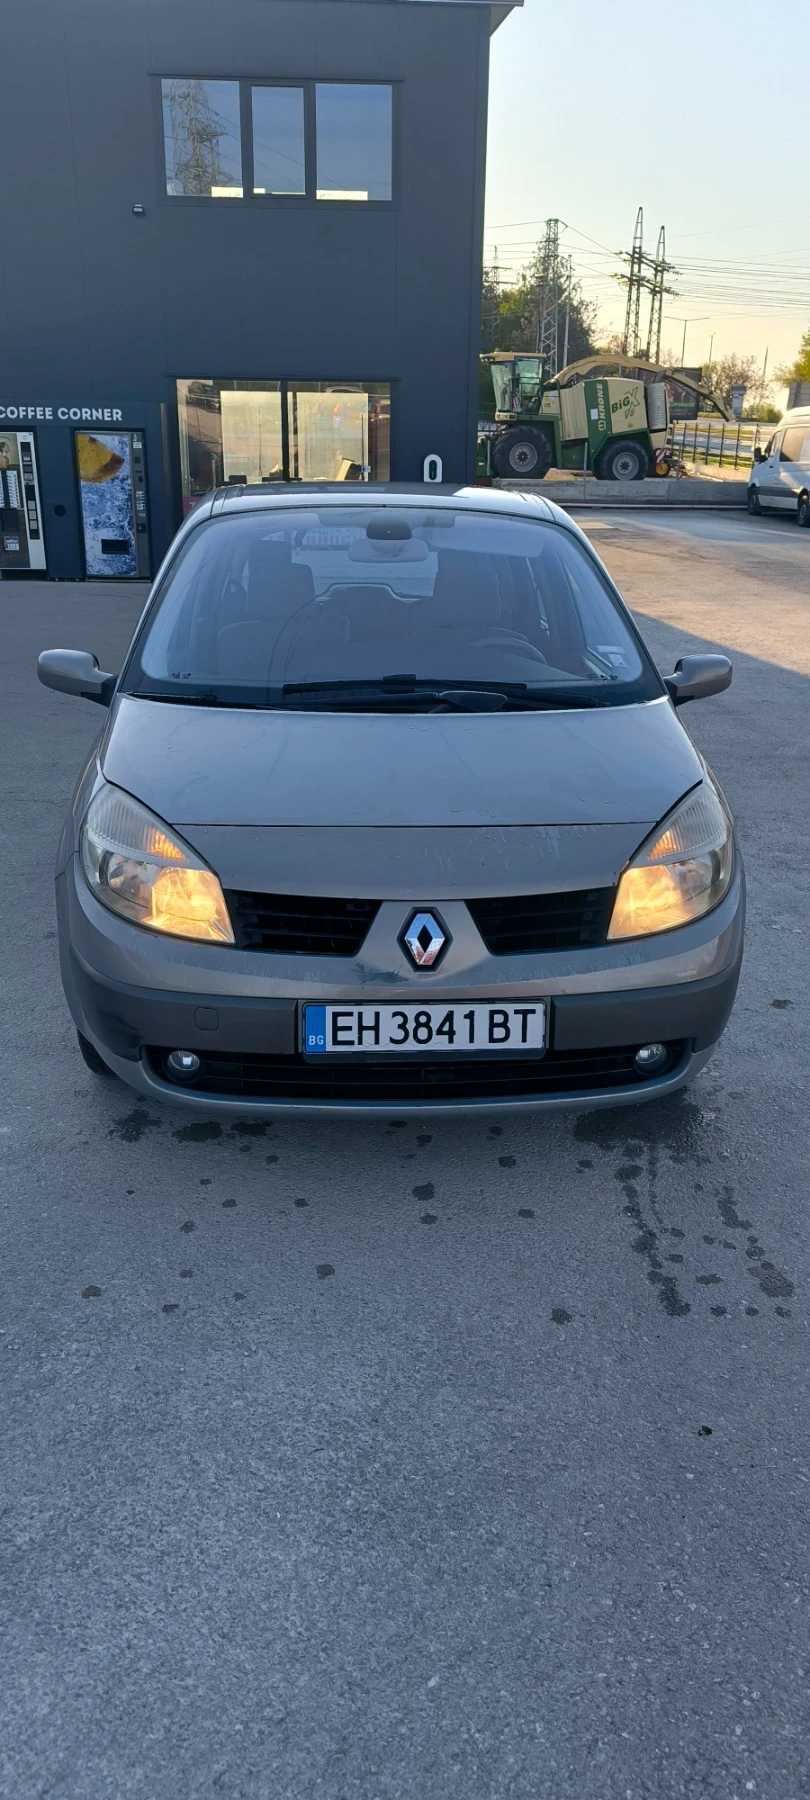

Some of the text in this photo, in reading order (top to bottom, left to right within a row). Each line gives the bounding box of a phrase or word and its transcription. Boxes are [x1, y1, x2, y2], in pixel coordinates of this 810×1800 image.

[57, 407, 123, 421] CORNER
[596, 383, 606, 420] KRONE
[331, 1008, 537, 1046] EH 3841 BT
[308, 1035, 324, 1046] BG
